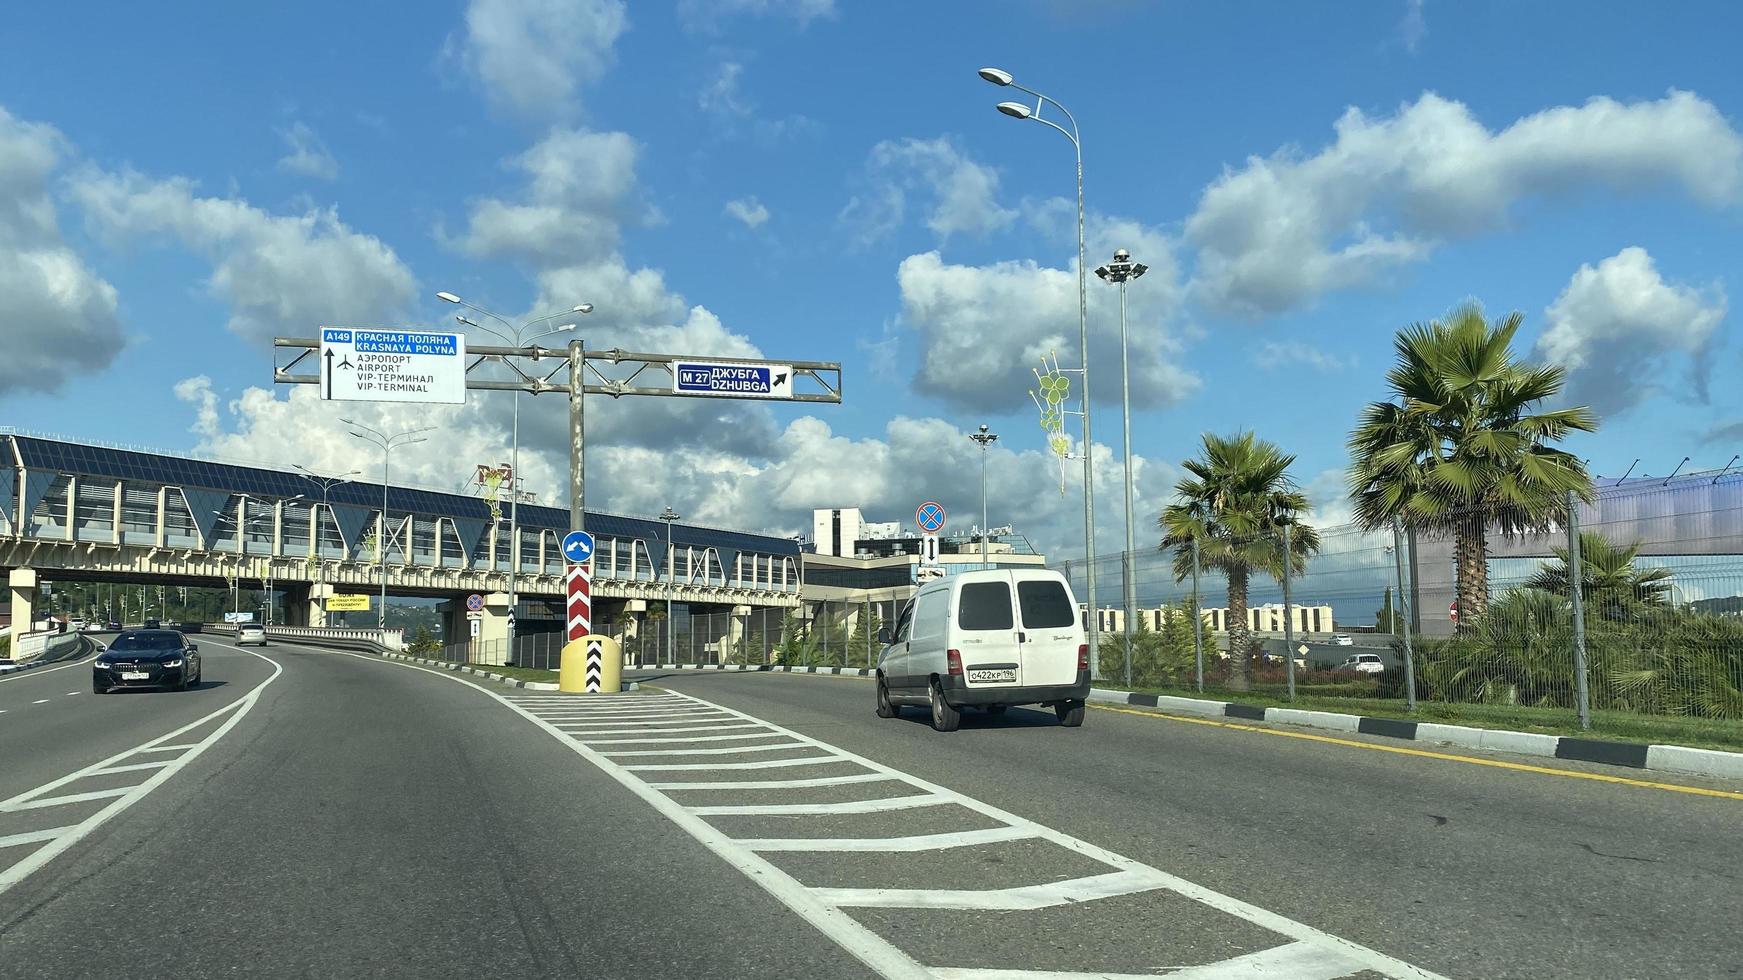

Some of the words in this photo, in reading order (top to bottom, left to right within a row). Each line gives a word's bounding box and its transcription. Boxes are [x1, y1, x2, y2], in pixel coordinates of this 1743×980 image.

[326, 332, 350, 342] А149
[356, 332, 405, 343] КРАСНАЯ
[408, 335, 451, 345] ПОЛЯНА
[356, 342, 412, 353] KRASNAYA
[415, 345, 456, 354] POLYNA
[357, 354, 412, 364] АЭРОПОРТ
[357, 363, 402, 373] AIRPORT
[357, 373, 434, 383] VIP-ТЕРМИНАЛ
[695, 373, 709, 383] 27
[711, 368, 760, 380] ДЖУБГА
[357, 382, 429, 393] VIP-TERMINAL
[711, 379, 769, 392] DZHUBGA
